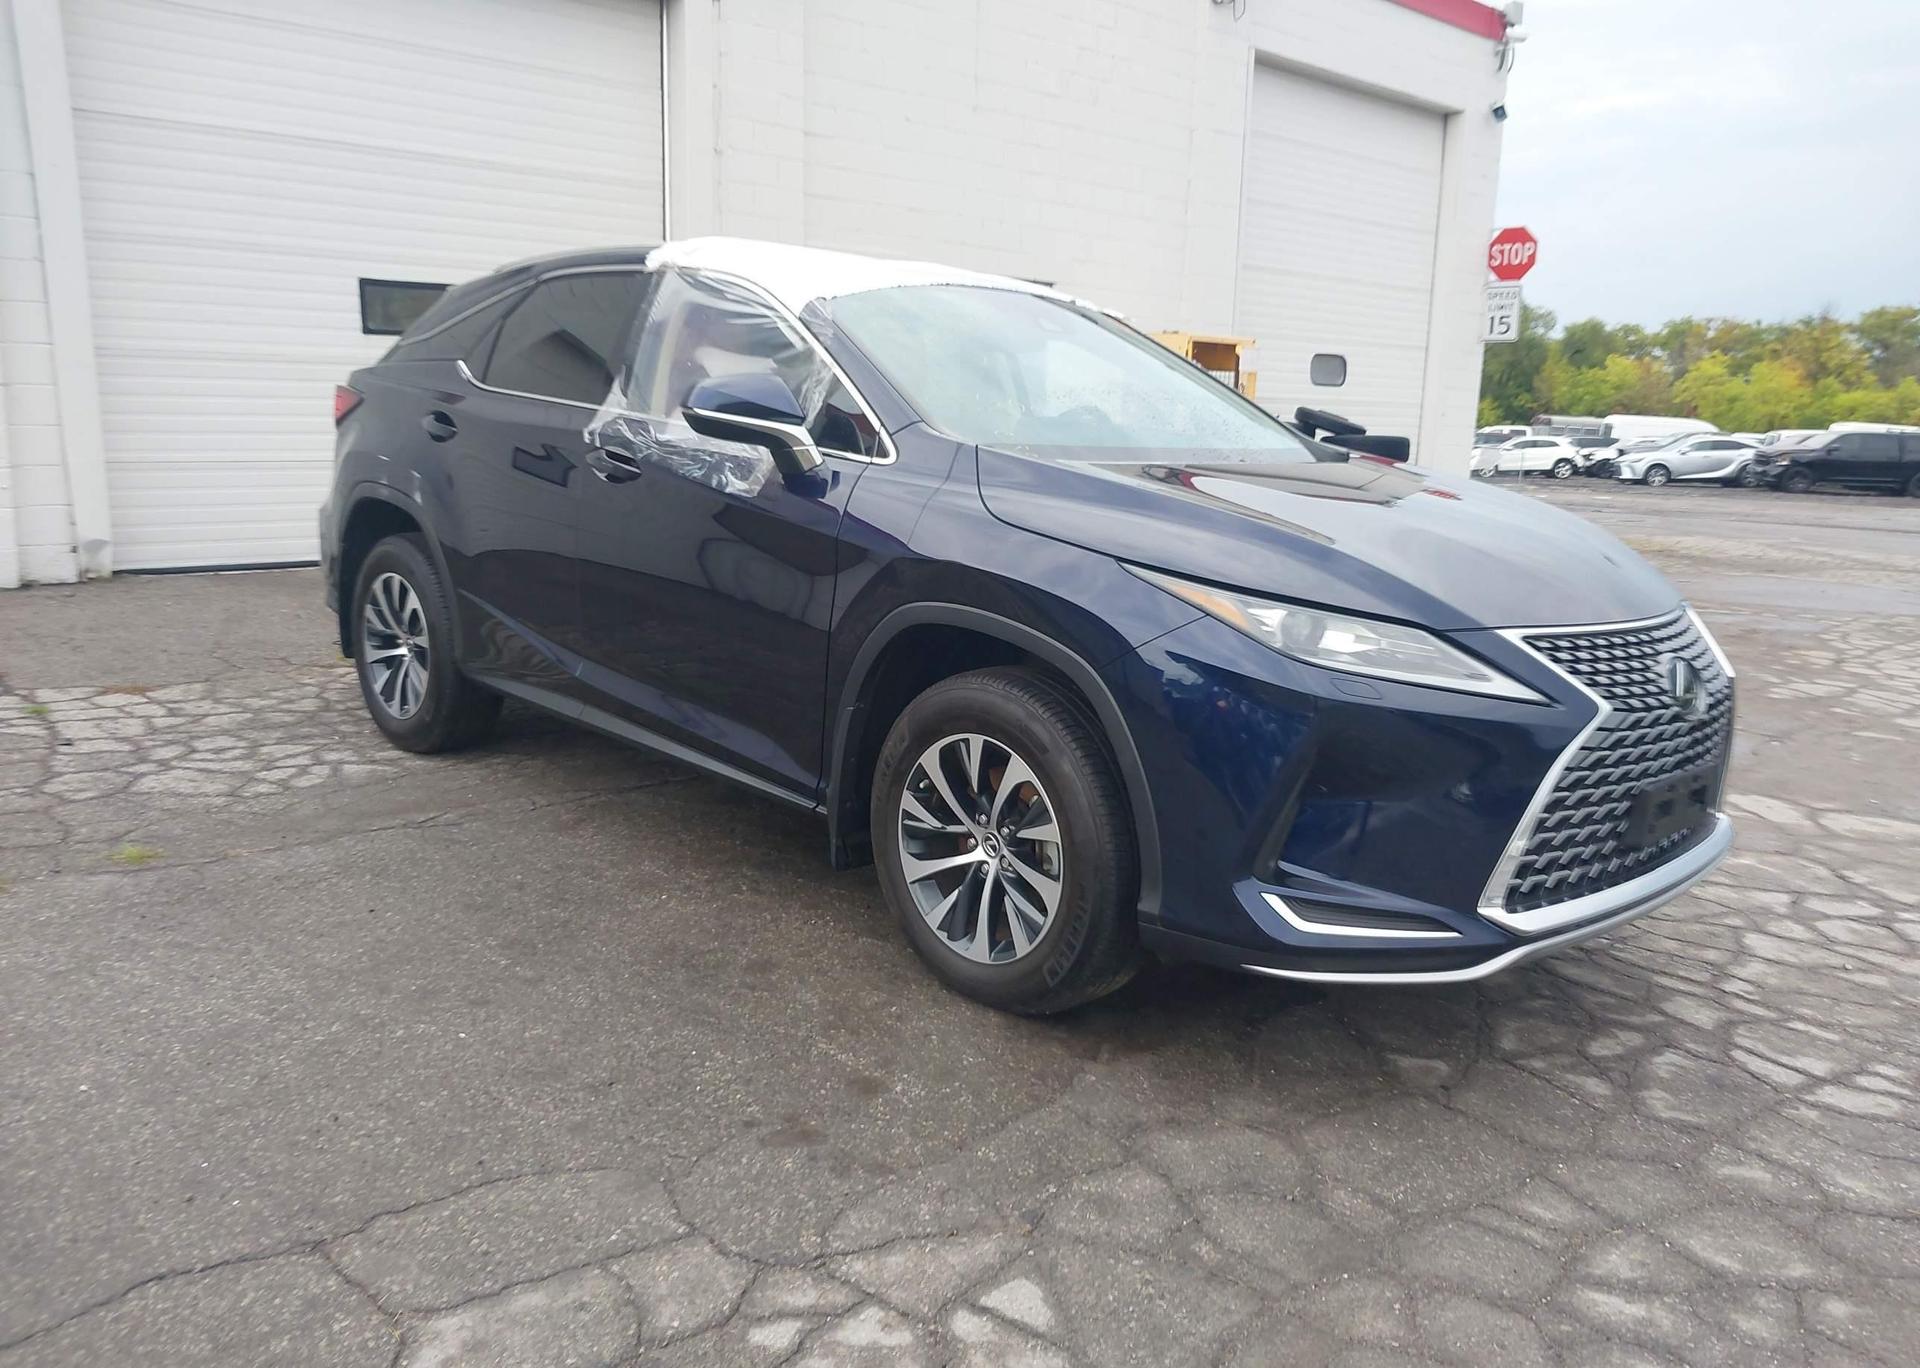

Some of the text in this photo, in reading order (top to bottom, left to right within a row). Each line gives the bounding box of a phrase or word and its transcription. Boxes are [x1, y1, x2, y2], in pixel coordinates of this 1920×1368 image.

[1489, 241, 1536, 267] STOP
[1488, 292, 1518, 301] SPEED
[1488, 302, 1515, 312] LIMIT
[1489, 315, 1512, 336] 15
